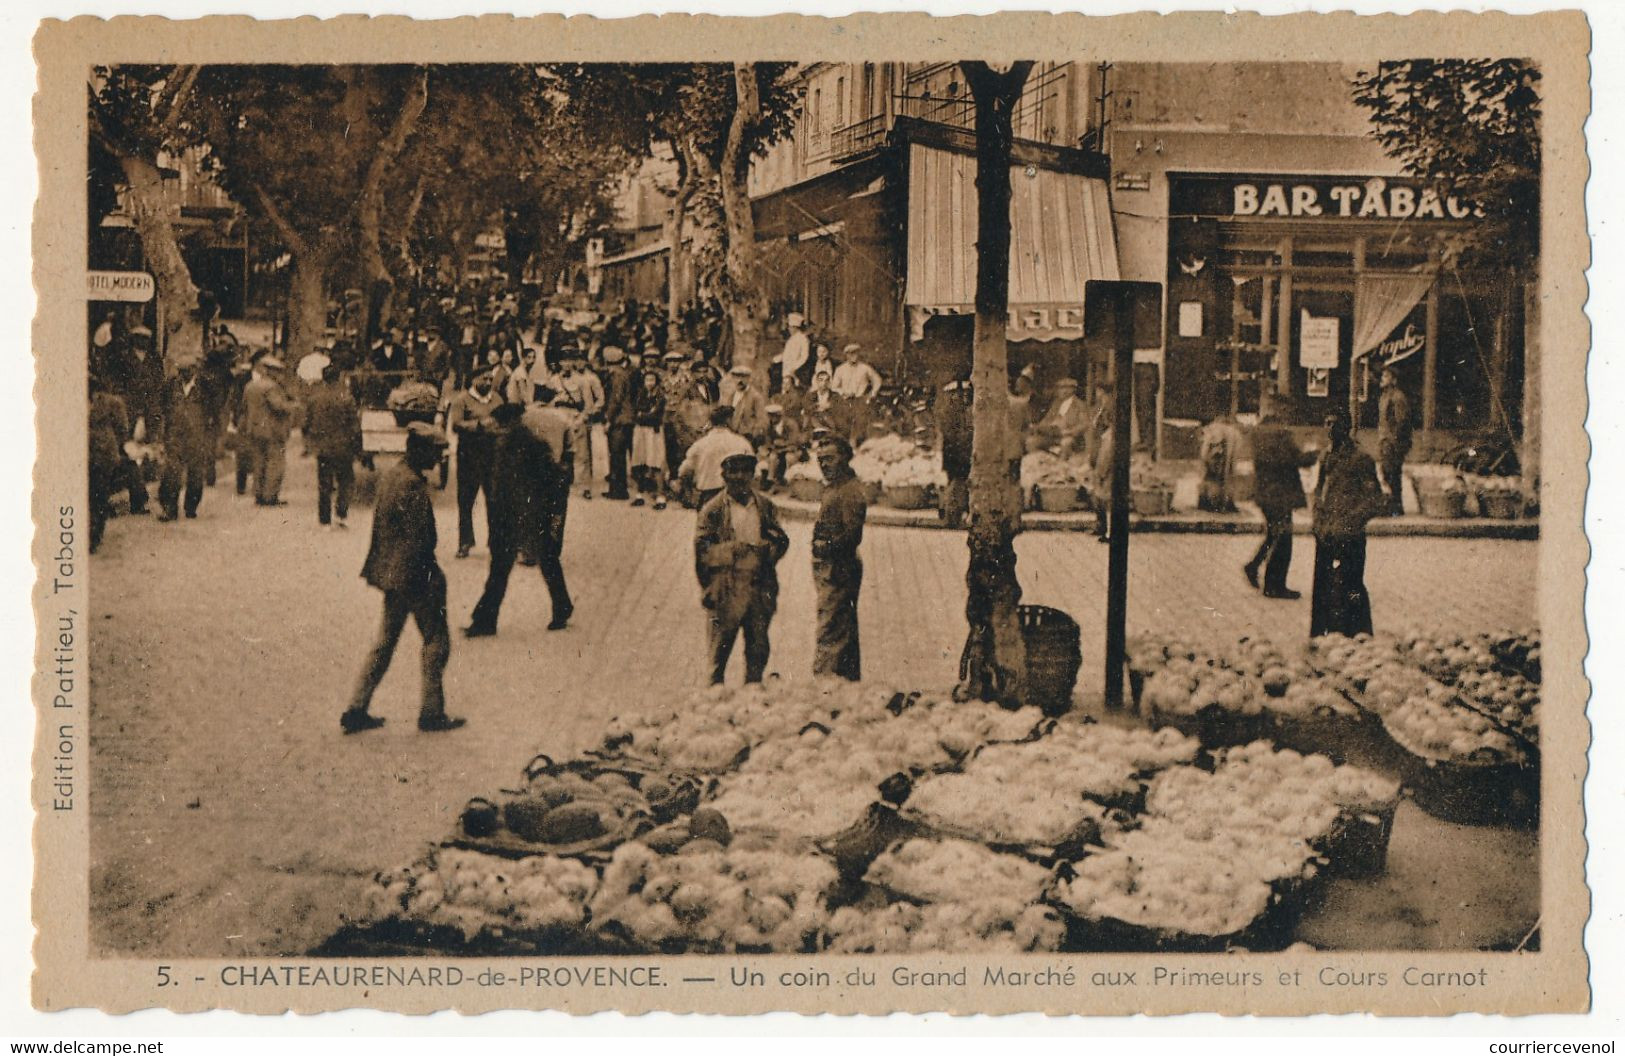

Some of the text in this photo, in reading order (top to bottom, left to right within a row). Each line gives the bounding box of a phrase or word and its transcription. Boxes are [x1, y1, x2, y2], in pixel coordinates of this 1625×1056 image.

[1233, 183, 1323, 216] BAR
[53, 505, 78, 811] Edition Pattieu, Tabacs
[157, 966, 179, 987] 5.
[220, 965, 668, 987] CHATEAURENARD-de-PROVENCE.
[730, 966, 765, 987] Un
[778, 967, 830, 987] coin
[845, 966, 876, 986] du
[891, 966, 967, 987] Grand
[983, 966, 1076, 987] Marché
[1091, 972, 1137, 987] aux
[1154, 966, 1263, 987] Primeurs
[1278, 967, 1303, 986] et
[1319, 966, 1388, 987] Cours
[1402, 966, 1488, 987] Carnot
